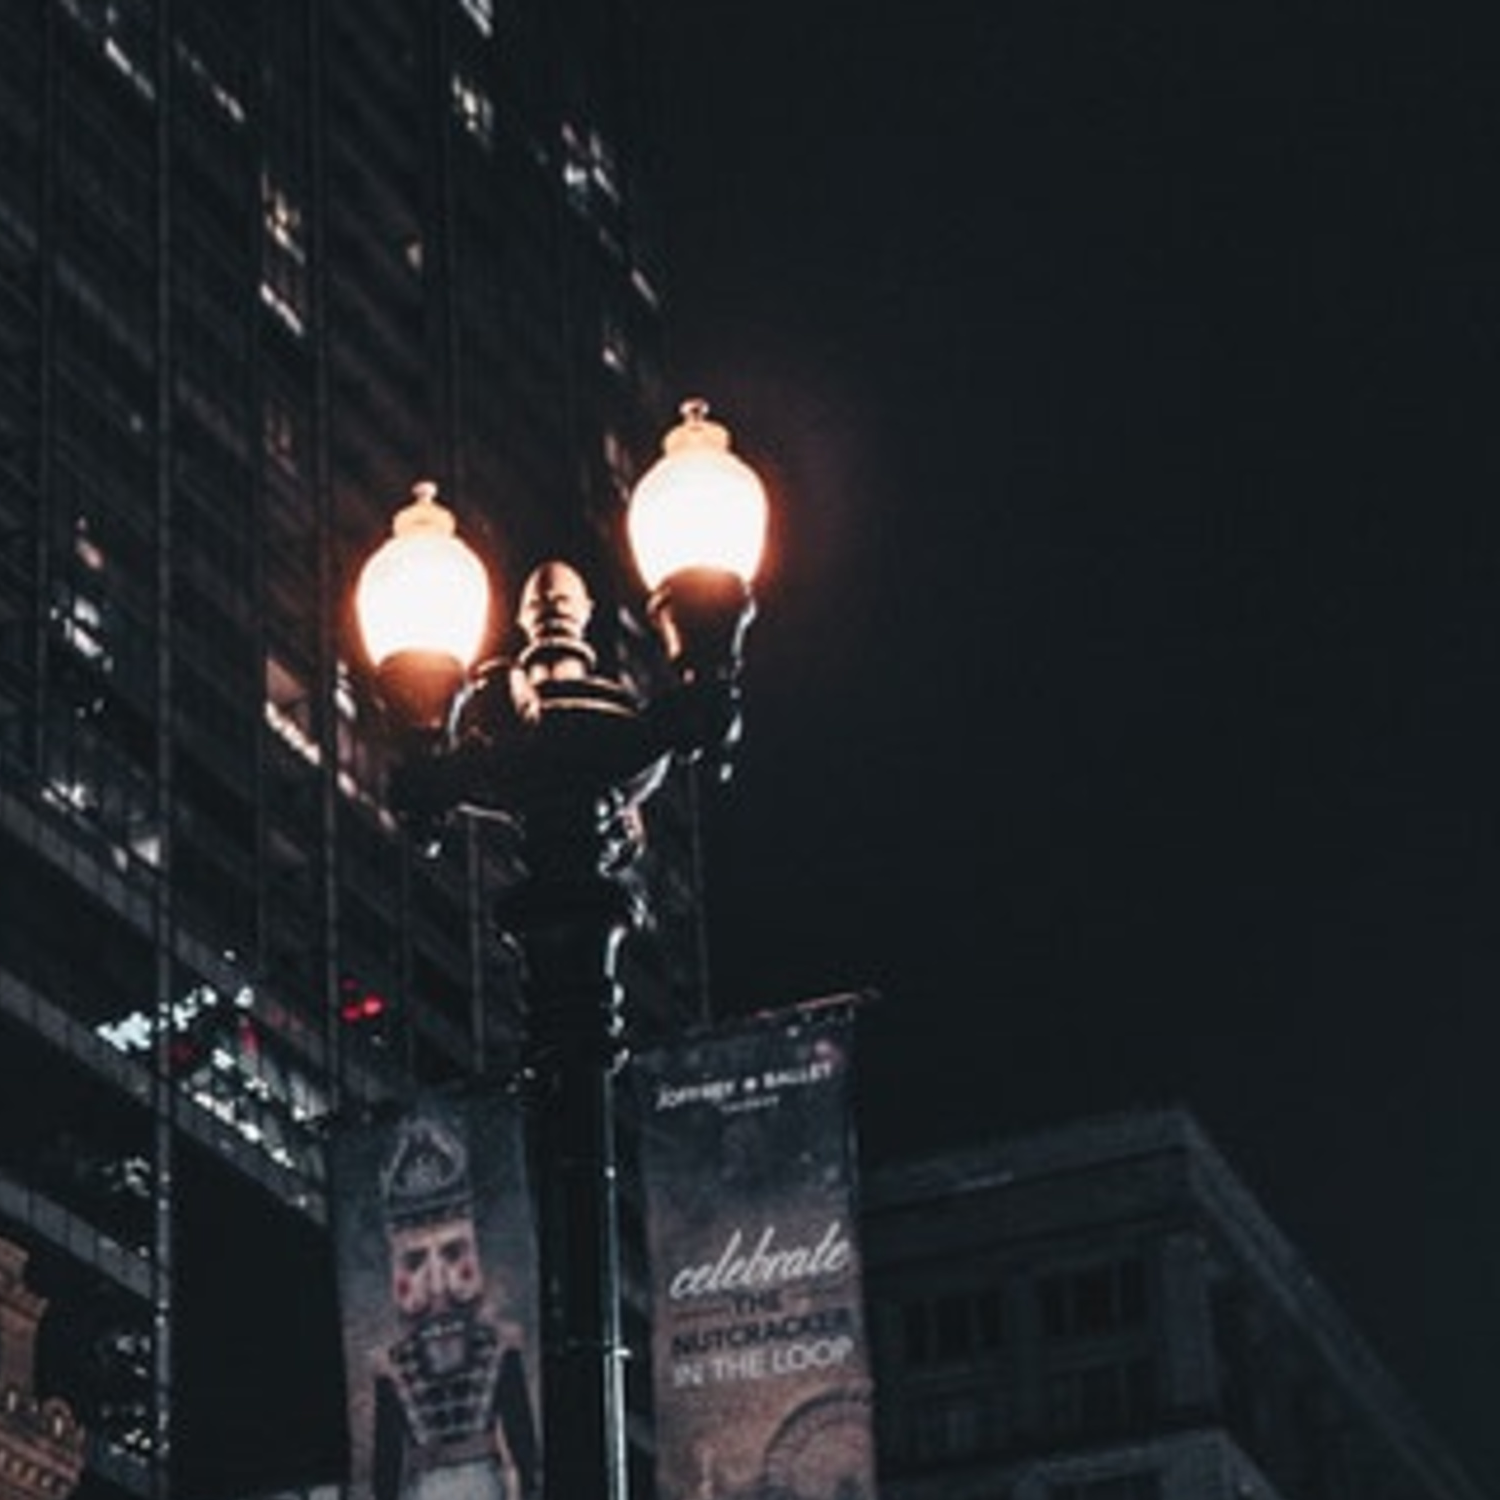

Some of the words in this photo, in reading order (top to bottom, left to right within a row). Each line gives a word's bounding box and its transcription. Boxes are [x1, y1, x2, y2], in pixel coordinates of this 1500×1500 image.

[669, 1220, 850, 1300] celebrate
[673, 1362, 704, 1389] IN
[711, 1350, 770, 1381] THE
[772, 1334, 855, 1374] LOOP
